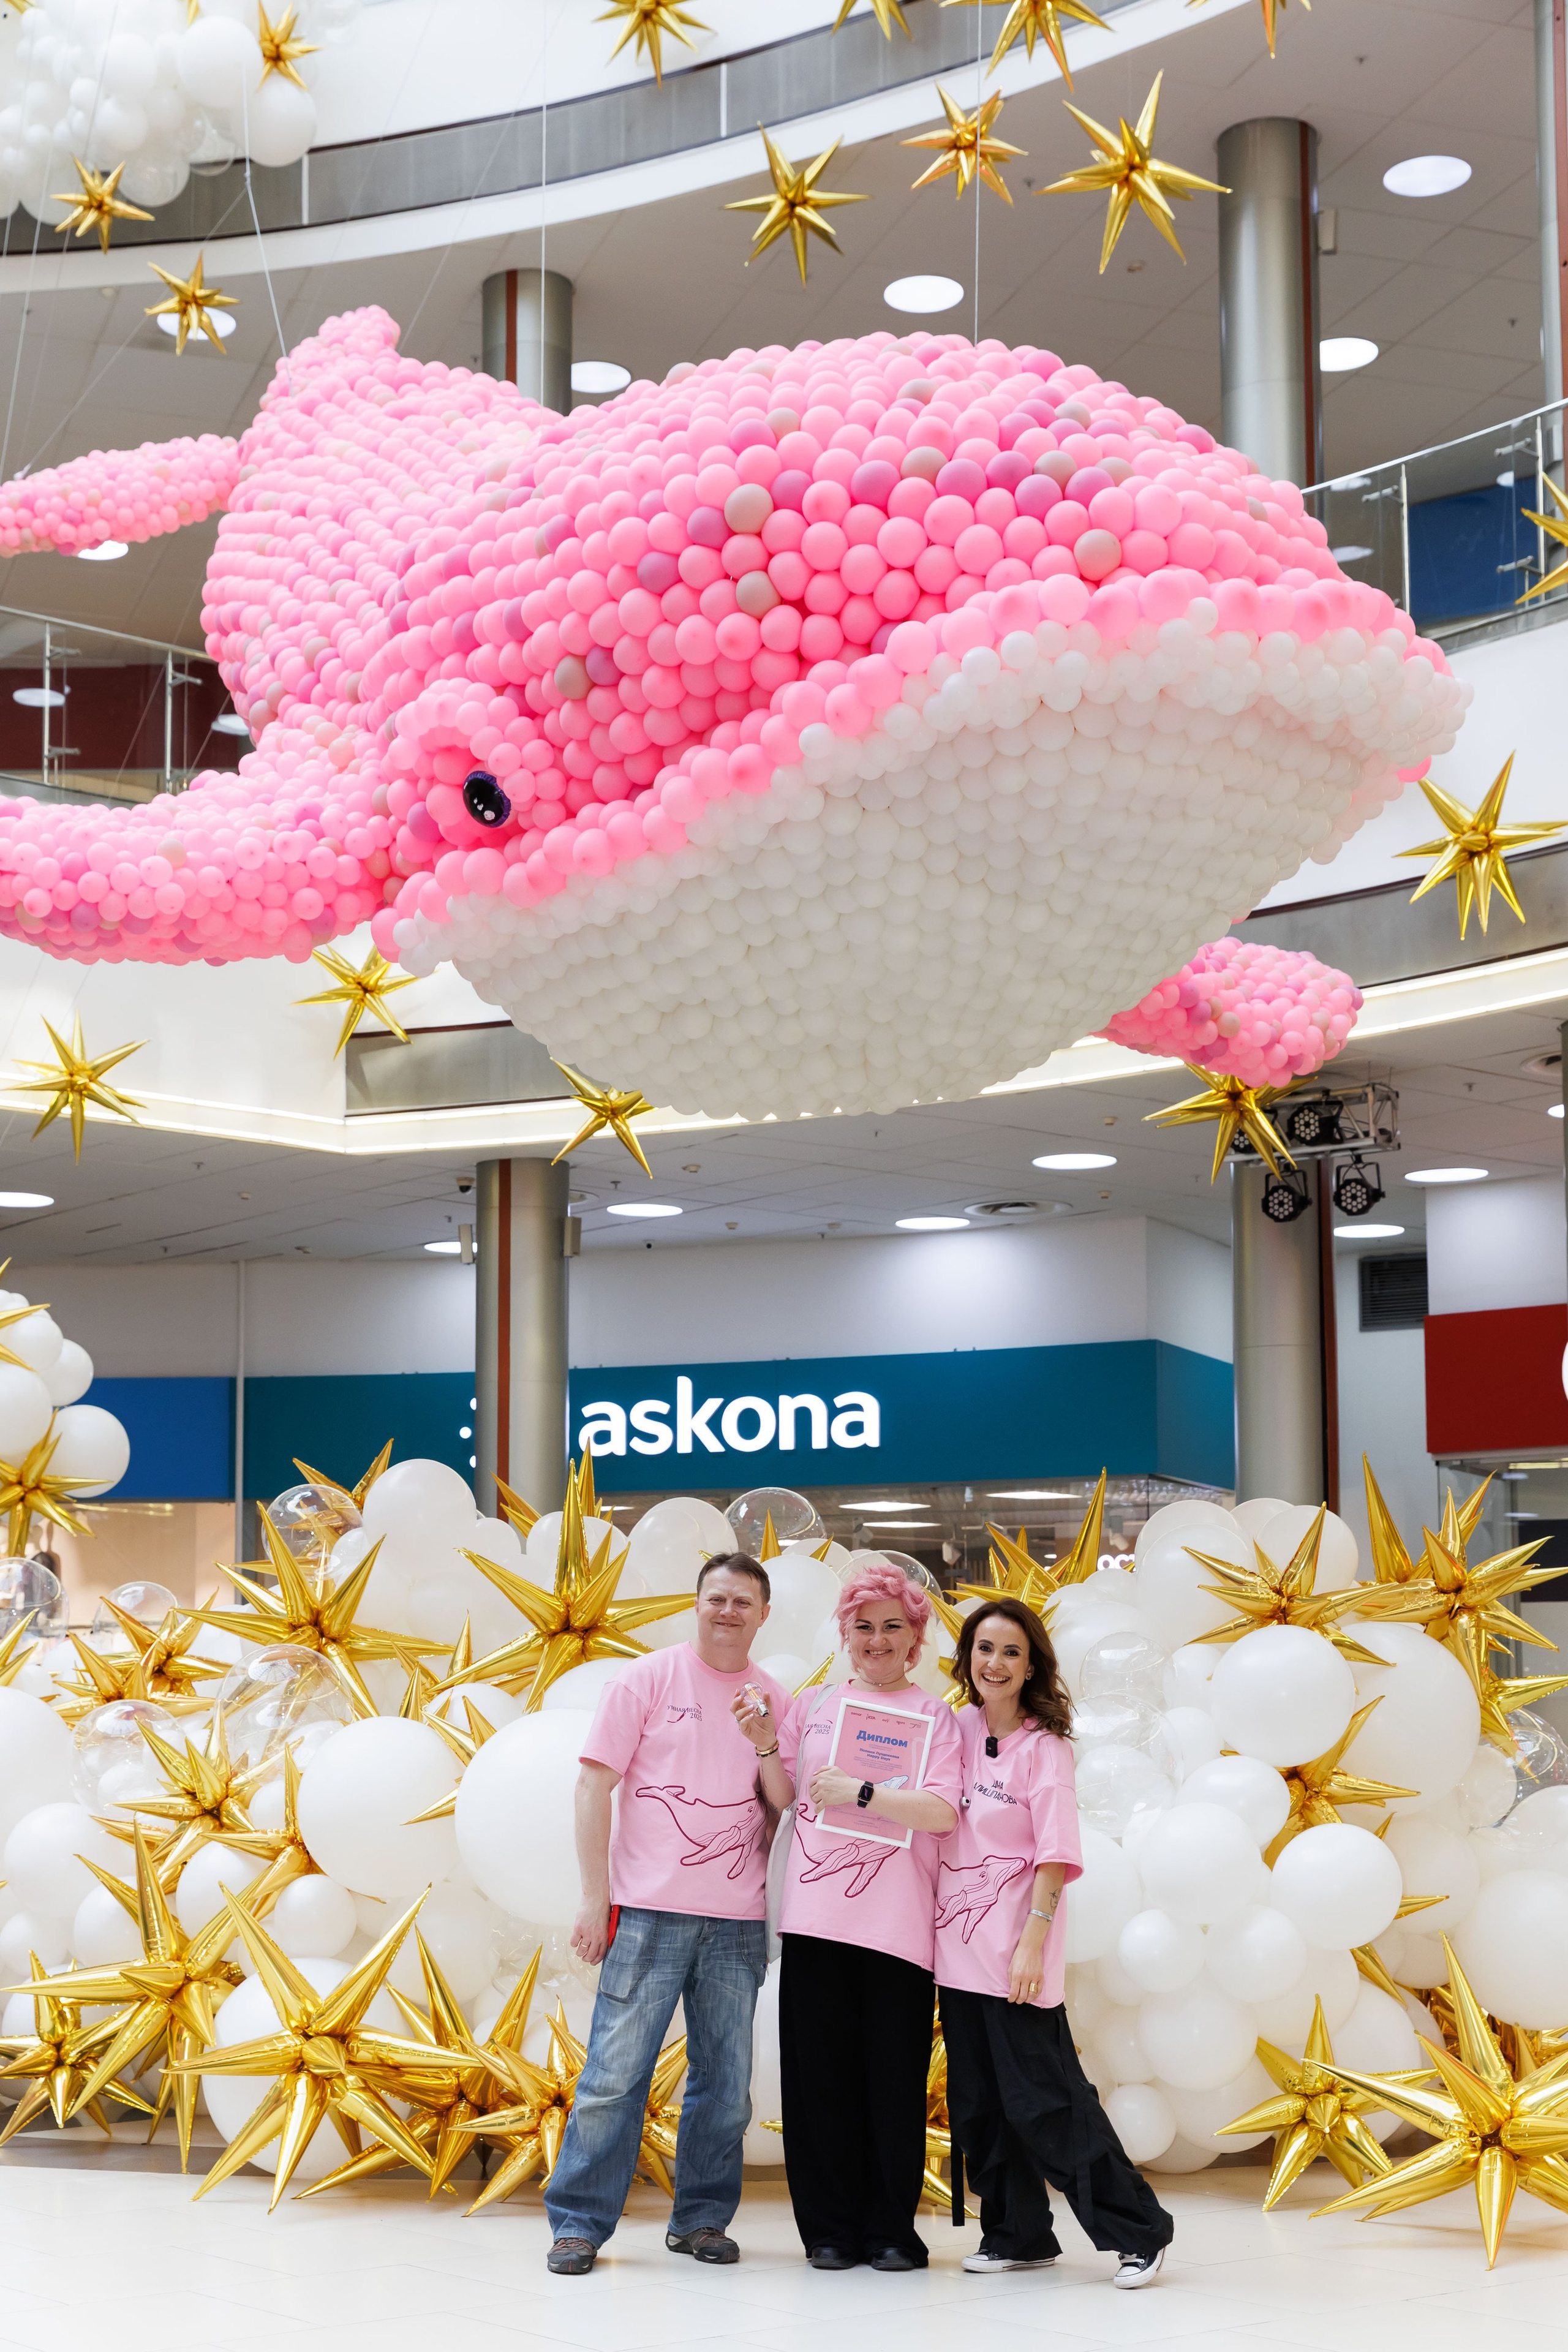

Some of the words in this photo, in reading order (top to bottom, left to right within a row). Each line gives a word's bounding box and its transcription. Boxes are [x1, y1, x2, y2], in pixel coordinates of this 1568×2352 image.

[578, 1376, 881, 1457] askona
[690, 1713, 702, 1721] 2025
[856, 1730, 908, 1747] Диплом
